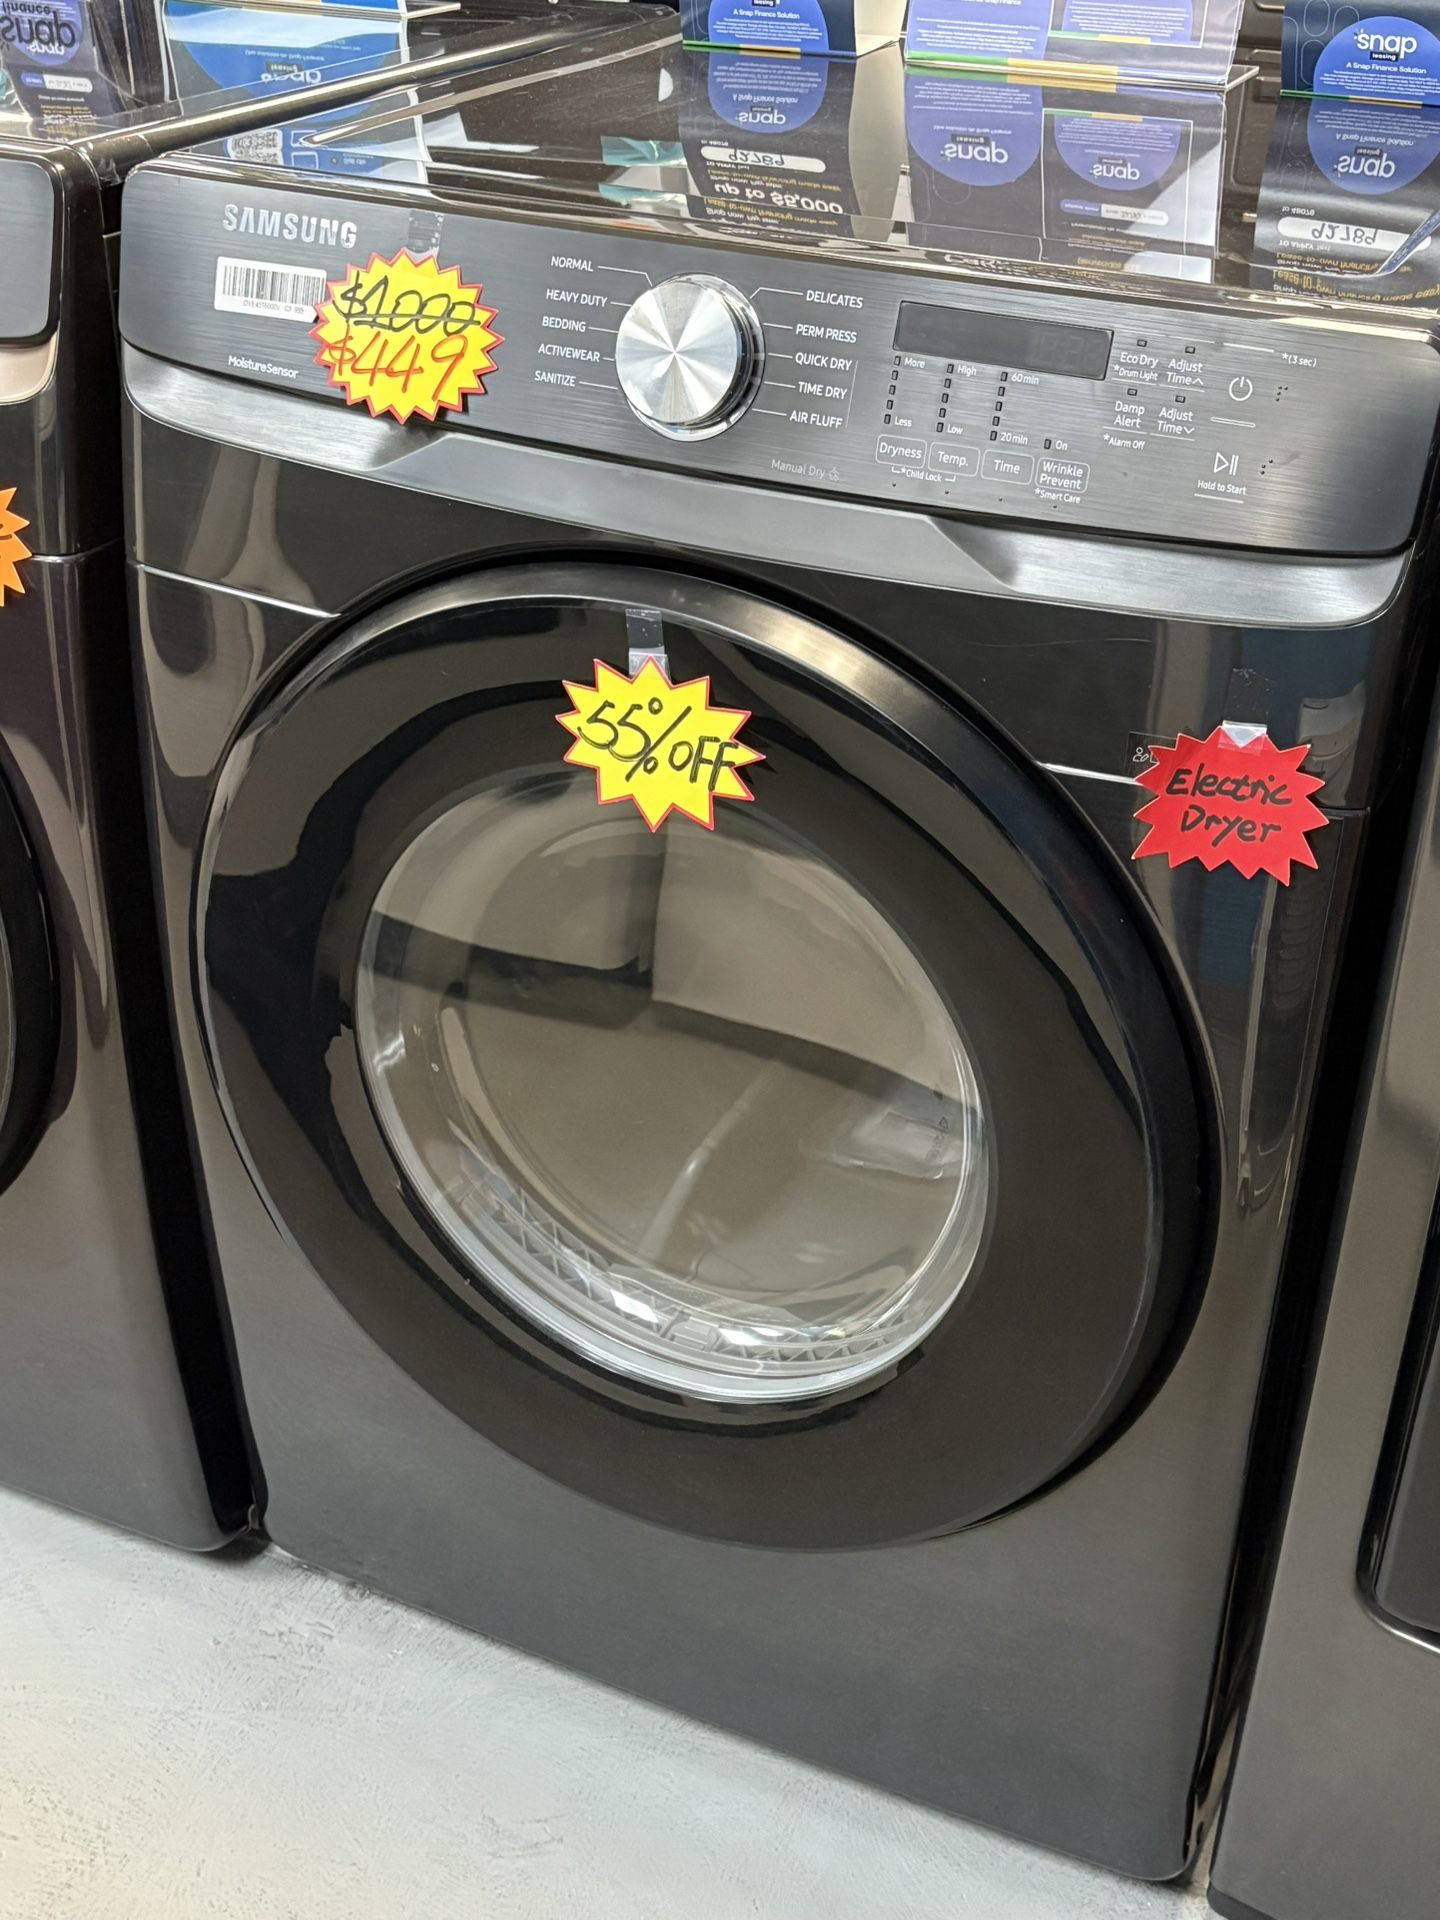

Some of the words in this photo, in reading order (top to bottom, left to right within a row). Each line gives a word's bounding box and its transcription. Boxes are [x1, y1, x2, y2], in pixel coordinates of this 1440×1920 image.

[754, 10, 776, 18] Finance
[1356, 33, 1418, 59] snap
[1372, 53, 1396, 61] leasing
[1353, 63, 1370, 71] Snap
[1372, 64, 1398, 72] Finance
[1400, 66, 1427, 74] Solution
[222, 203, 358, 249] SAMSUNG
[551, 256, 594, 272] NORMAL
[546, 289, 581, 305] HEAVY
[580, 293, 608, 308] DUTY
[806, 290, 864, 309] DELICATES
[542, 316, 587, 333] BEDDING
[796, 324, 825, 341] PERM
[826, 328, 858, 344] PRESS
[538, 344, 601, 363] ACTIVEWEAR
[228, 355, 300, 379] MoistureSensor
[328, 322, 469, 402] $449
[796, 353, 828, 369] QUICK
[829, 357, 853, 372] DRY
[904, 357, 926, 369] More
[1168, 358, 1204, 374] Adjust
[1298, 356, 1318, 368] sec)
[958, 365, 977, 377] High
[1139, 369, 1159, 382] Light
[1166, 372, 1193, 386] Time
[534, 371, 576, 388] SANITIZE
[798, 382, 823, 397] TIME
[824, 386, 848, 400] DRY
[1114, 401, 1145, 416] Damp
[1158, 407, 1194, 423] Adjust
[790, 410, 809, 425] AIR
[810, 413, 843, 430] FLUFF
[894, 417, 913, 428] Less
[1114, 416, 1142, 429] Alert
[1157, 421, 1183, 435] Time
[947, 424, 964, 436] Low
[879, 442, 923, 460] Dryness
[1055, 440, 1068, 451] On
[1132, 440, 1146, 450] Off
[938, 451, 969, 467] Temp.
[771, 458, 807, 475] Manual
[808, 465, 826, 480] Dry
[994, 460, 1021, 475] Time
[1042, 461, 1084, 478] Wrinkle
[925, 471, 943, 482] Lock
[1040, 474, 1082, 490] Prevent
[1198, 480, 1217, 492] Hold
[1218, 483, 1226, 492] to
[1226, 484, 1247, 496] Start
[1064, 492, 1081, 504] Care
[577, 697, 692, 782] 55%
[668, 736, 739, 792] OFF
[1166, 763, 1292, 804] Electric
[1181, 805, 1281, 847] Dryer
